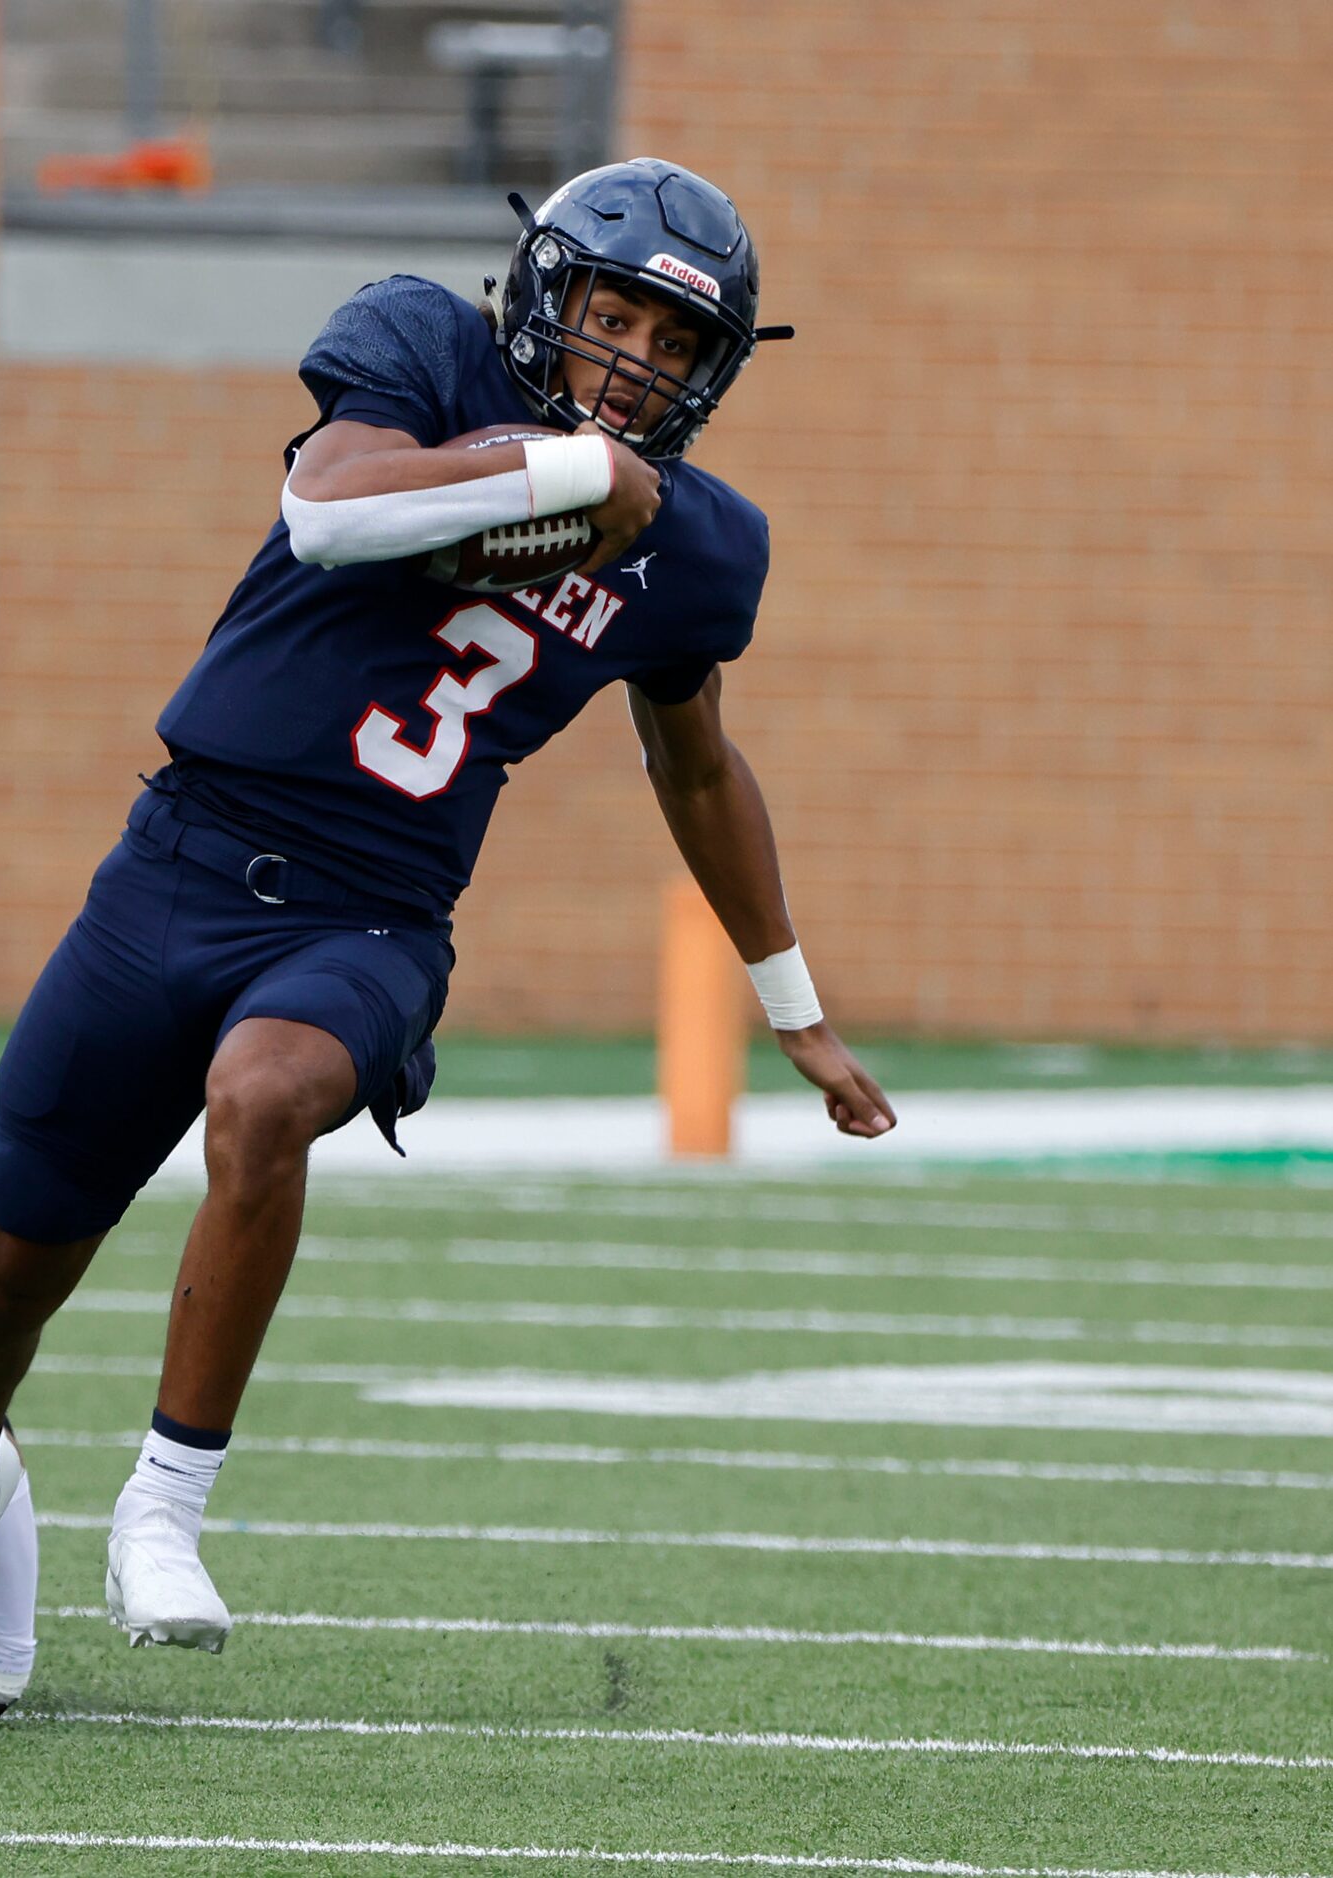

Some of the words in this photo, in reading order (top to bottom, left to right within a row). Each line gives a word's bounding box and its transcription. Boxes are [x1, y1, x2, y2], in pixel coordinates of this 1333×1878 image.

[659, 258, 717, 297] Riddell
[505, 566, 626, 653] LEN
[349, 597, 539, 803] 3
